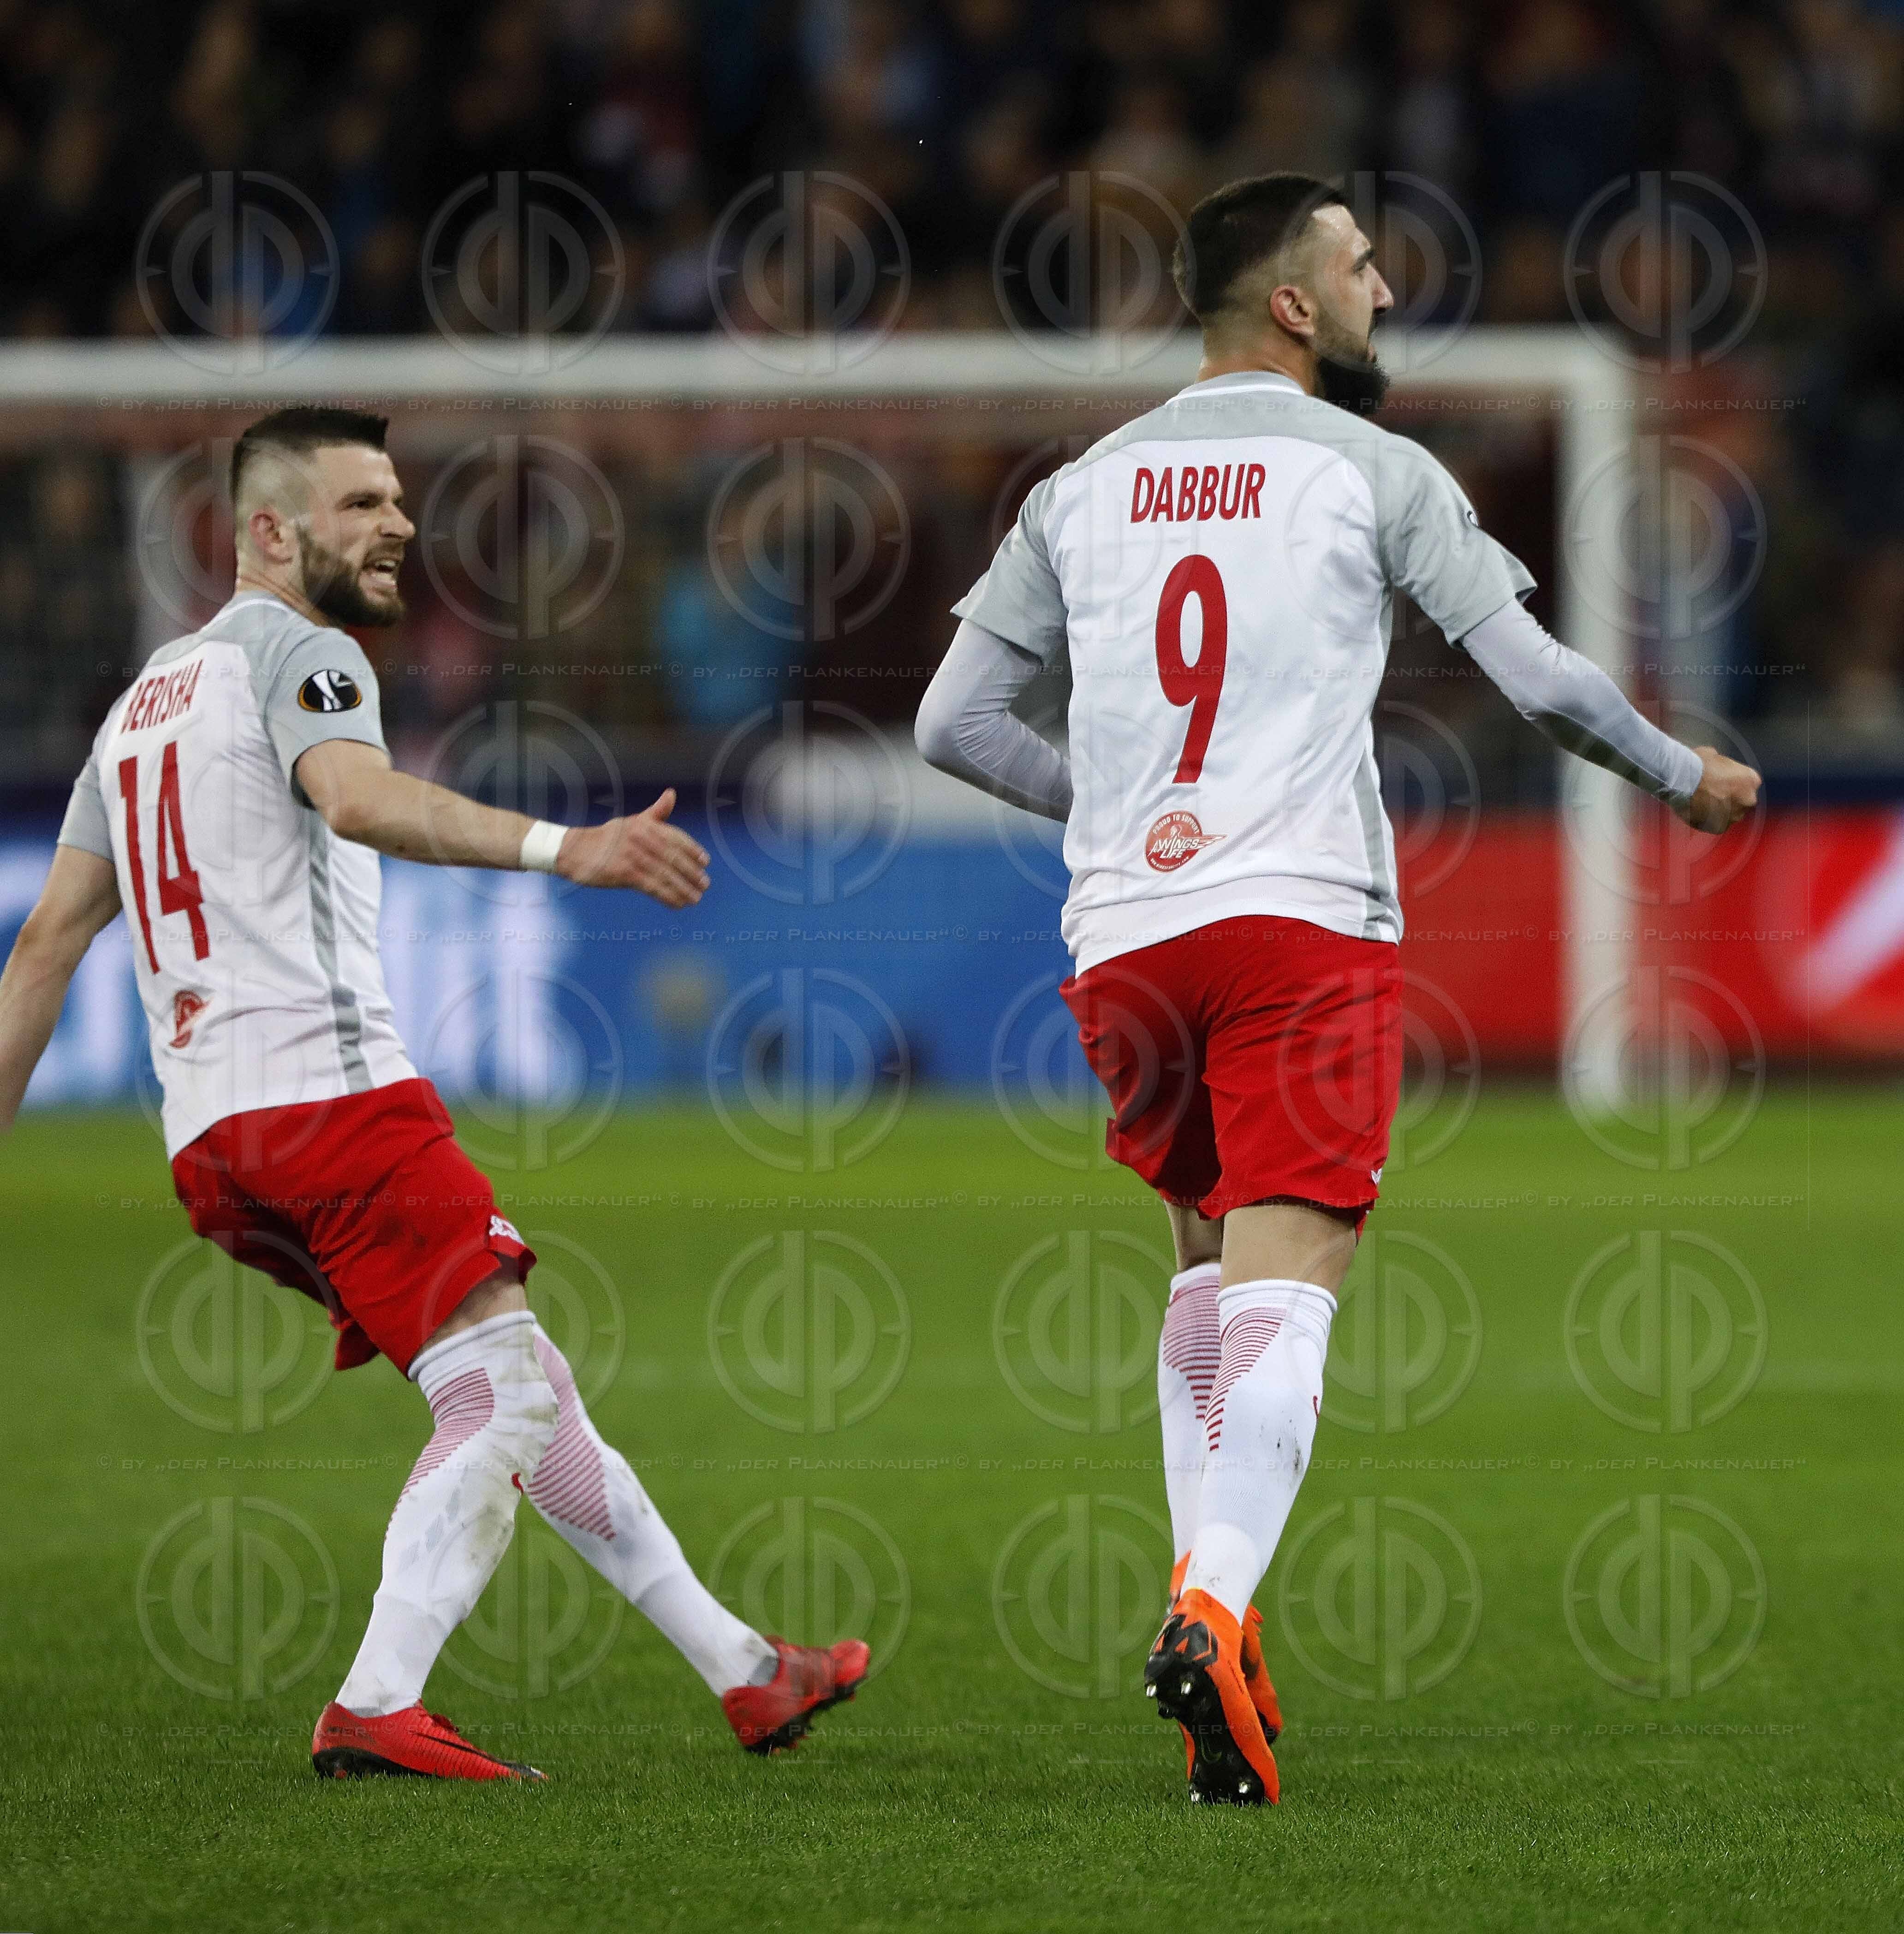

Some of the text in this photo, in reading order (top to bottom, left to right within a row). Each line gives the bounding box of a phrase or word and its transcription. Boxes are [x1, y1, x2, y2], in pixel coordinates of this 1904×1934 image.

[1130, 463, 1265, 523] DABBUR
[1154, 554, 1227, 784] 9
[1153, 816, 1171, 834] PROUD
[1182, 815, 1200, 834] SUPPORT
[1158, 836, 1201, 850] WINGS
[119, 741, 209, 974] 14
[1159, 848, 1186, 859] LIFE
